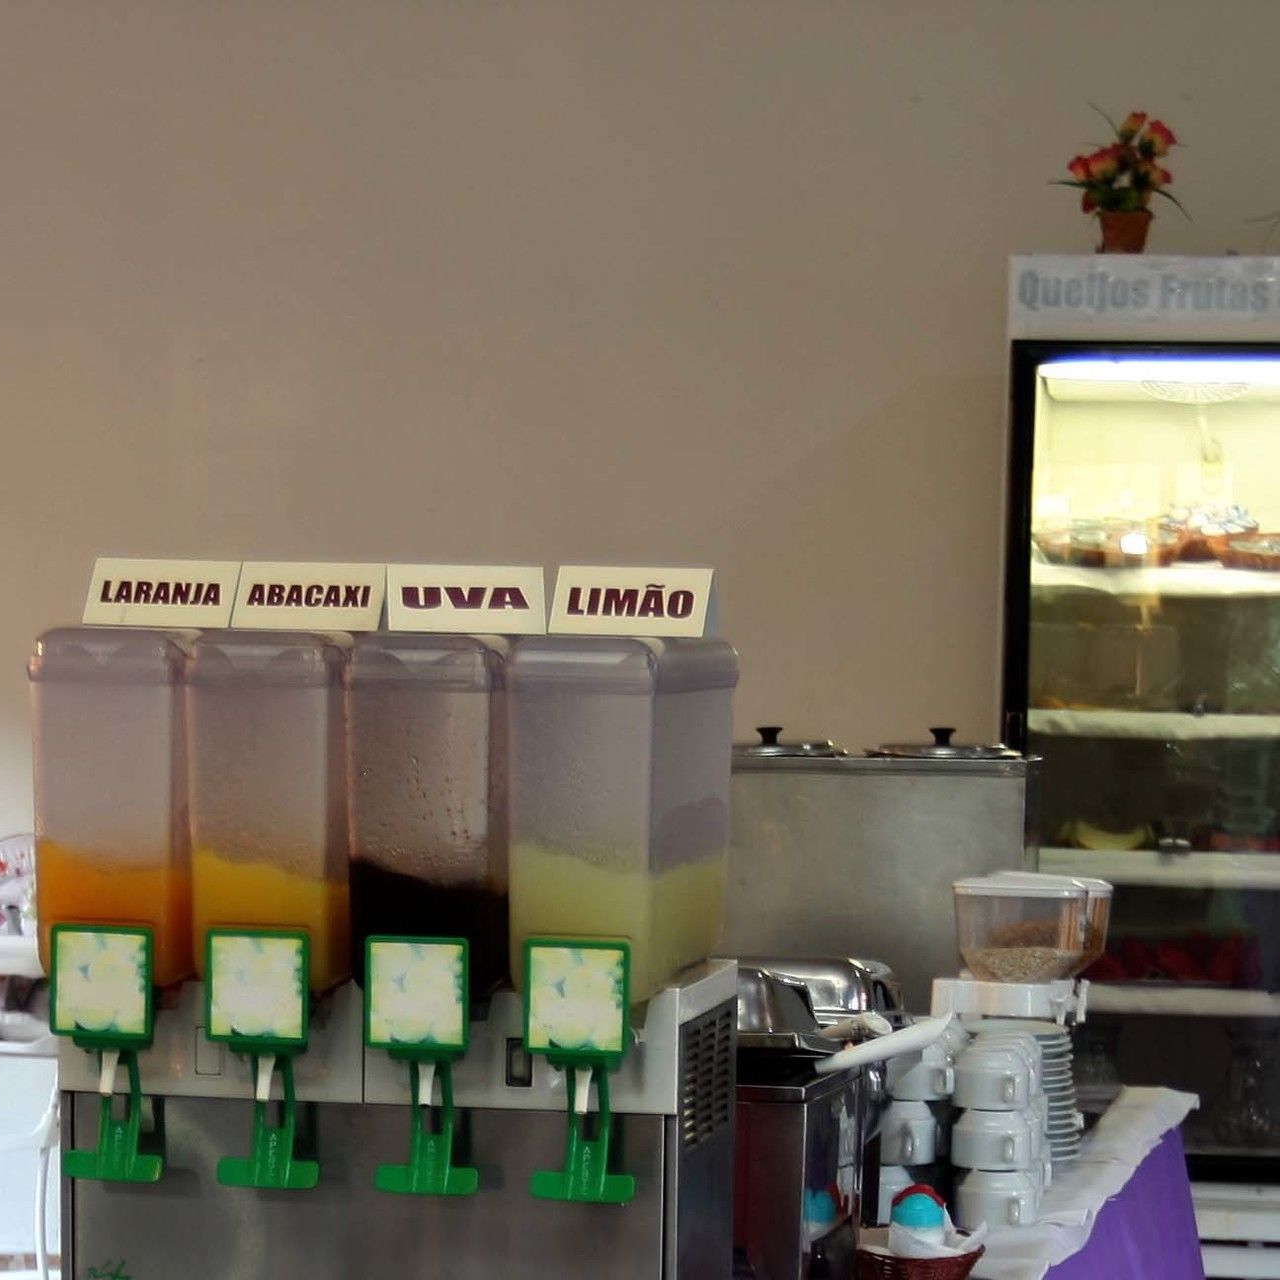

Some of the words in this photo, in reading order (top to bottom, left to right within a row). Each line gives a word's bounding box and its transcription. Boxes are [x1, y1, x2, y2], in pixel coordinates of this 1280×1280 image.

[1020, 270, 1151, 310] Queijos
[1161, 274, 1266, 313] Frutas
[99, 580, 221, 606] LARANJA
[246, 583, 372, 608] ABACAXI
[401, 585, 530, 610] UVA
[566, 583, 695, 619] LIMÃO
